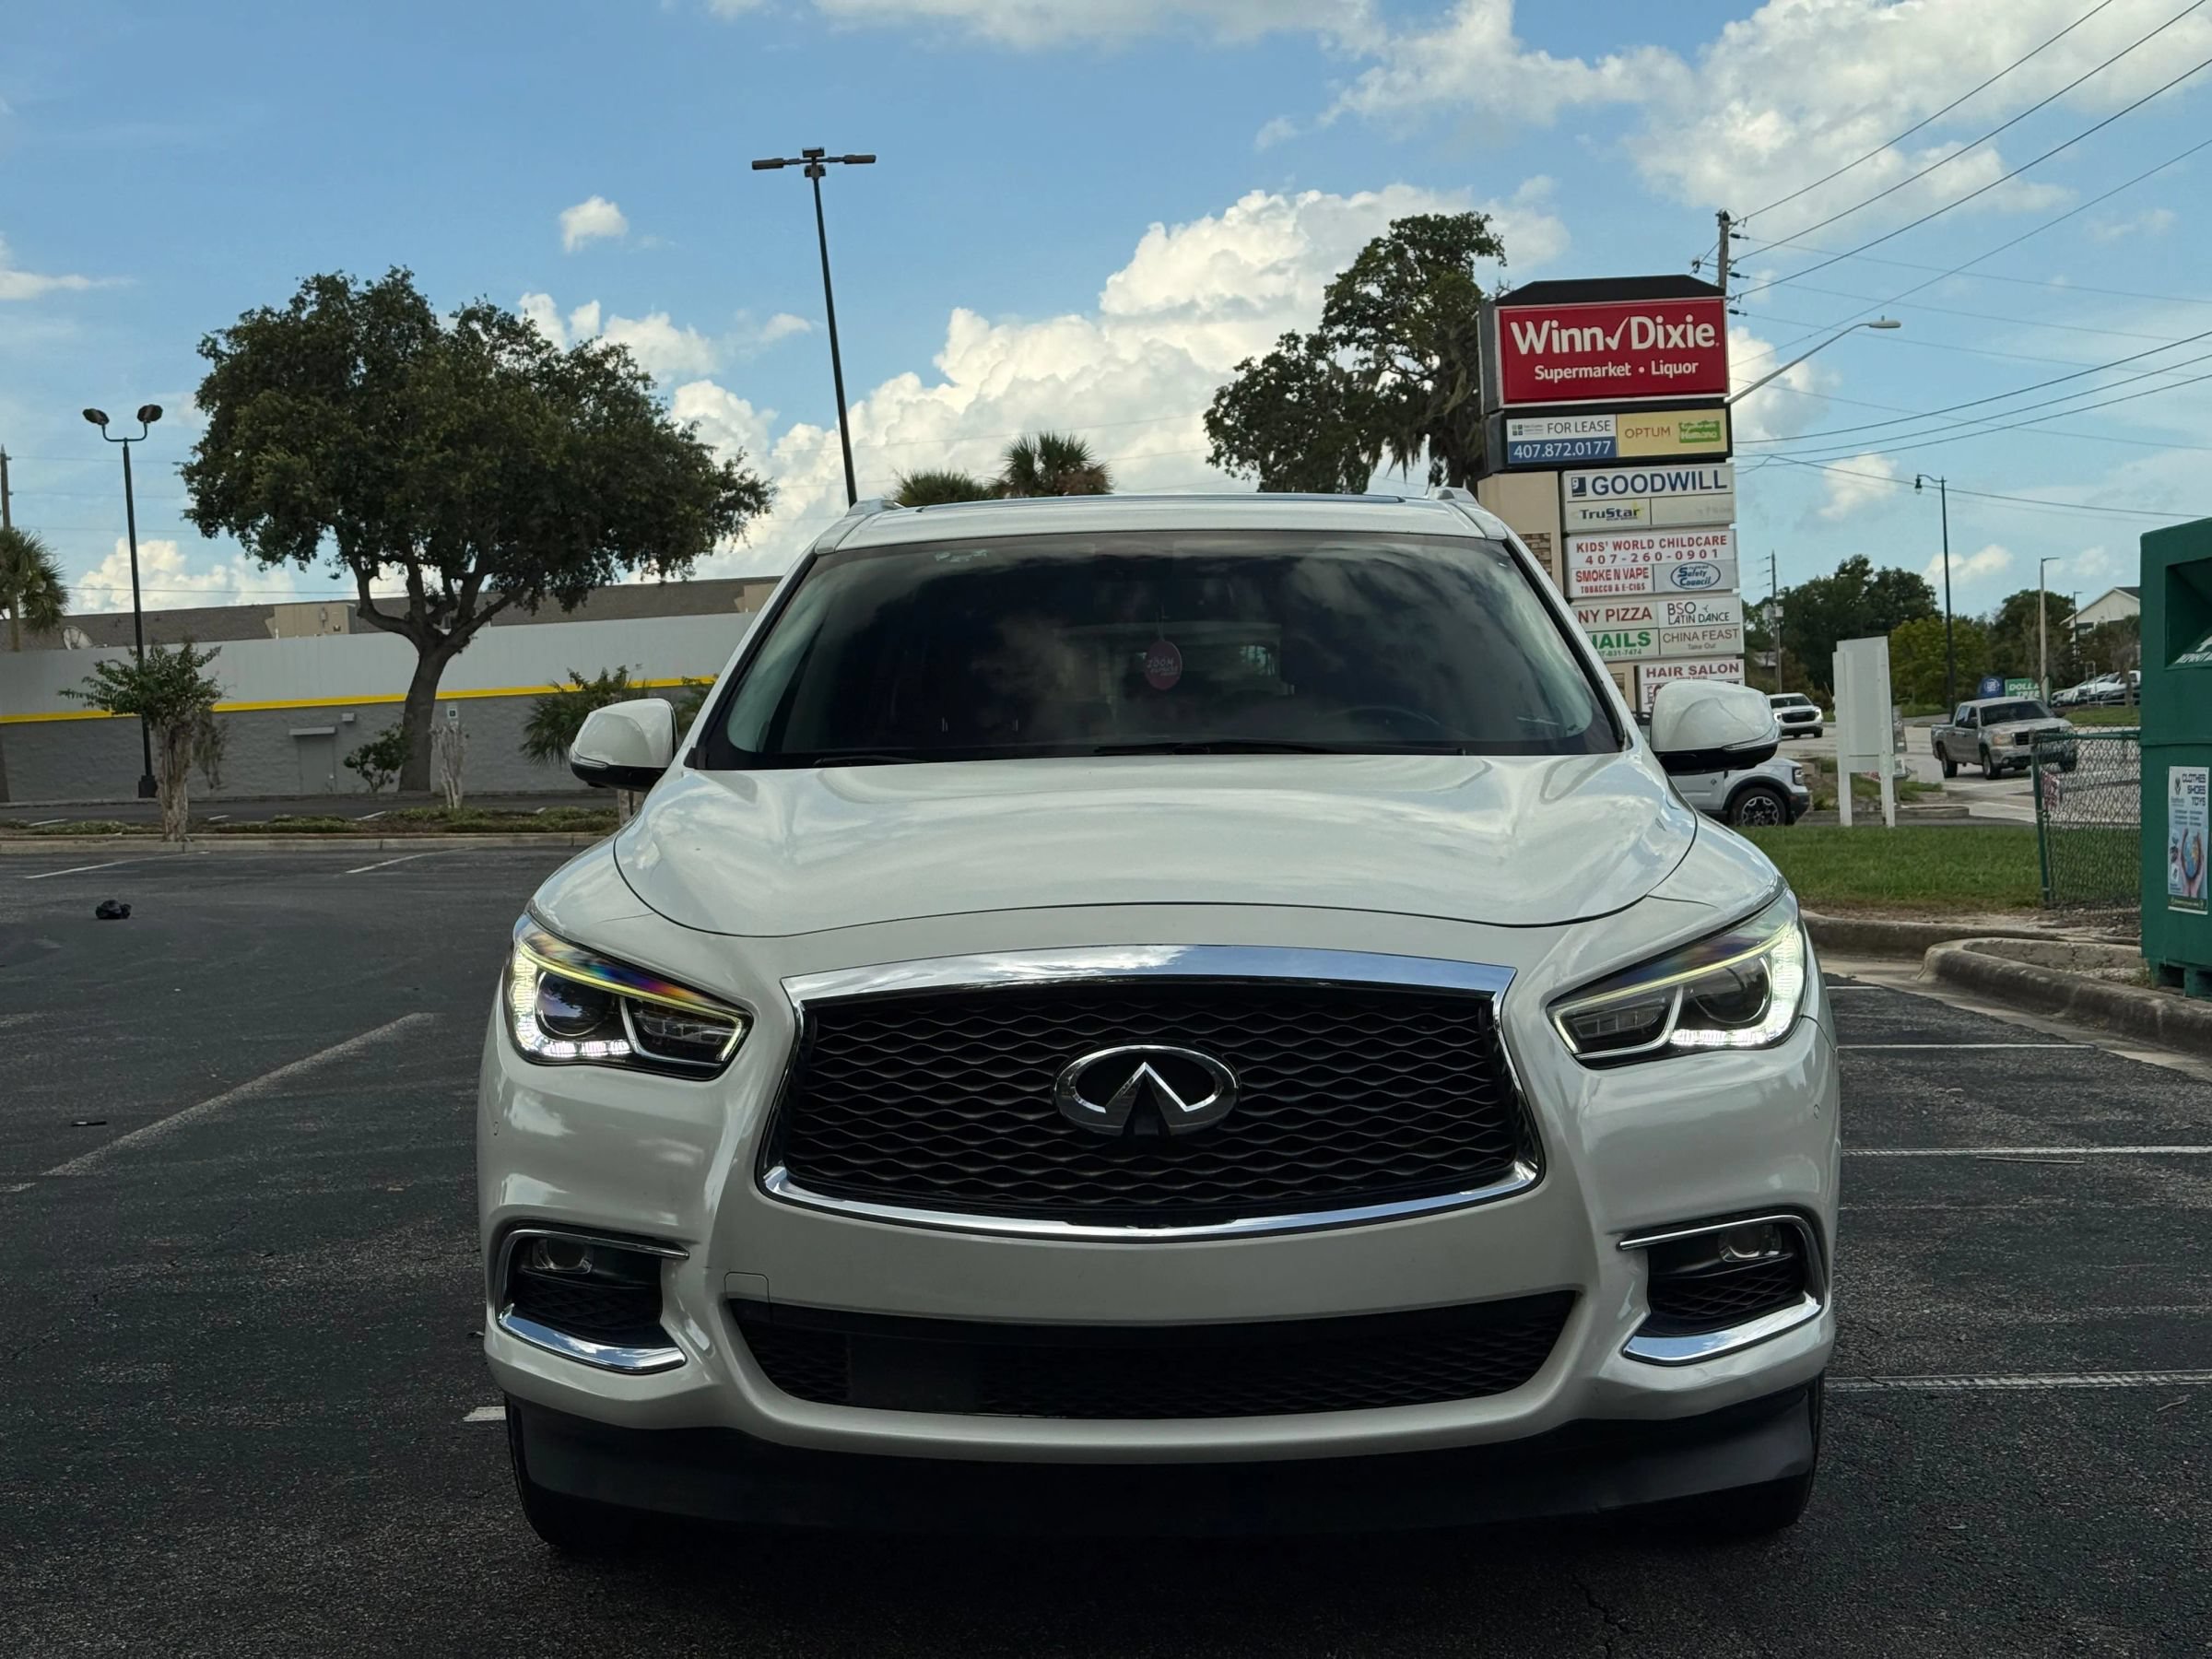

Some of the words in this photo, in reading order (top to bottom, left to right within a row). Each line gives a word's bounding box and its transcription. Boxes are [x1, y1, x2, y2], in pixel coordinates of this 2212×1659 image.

[1510, 320, 1604, 355] Winn
[1630, 314, 1715, 350] Dixie
[1535, 361, 1631, 383] Supermarket
[1651, 359, 1699, 378] Liquor
[1547, 421, 1571, 434] FOR
[1574, 420, 1611, 433] LEASE
[1624, 427, 1671, 439] OPTUM
[1513, 441, 1611, 459] 407.872.0177
[1592, 470, 1728, 496] GOODWILL
[1580, 507, 1641, 520] TruStar
[1576, 541, 1609, 553] KIDS'
[1613, 539, 1655, 551] WORLD
[1659, 535, 1728, 549] CHILDCARE
[1585, 548, 1720, 565] 407-260-0901
[1575, 569, 1612, 582] SMOKE
[1614, 569, 1621, 581] N
[1623, 567, 1650, 580] VAPE
[1677, 566, 1708, 579] Safety
[1581, 584, 1613, 594] TOBACCO
[1621, 582, 1645, 592] E-CIGS
[1680, 576, 1712, 586] Council
[1578, 609, 1601, 624] NY
[1606, 606, 1653, 622] PIZZA
[1667, 602, 1697, 616] BSO
[1668, 613, 1696, 625] LATIN
[1698, 611, 1730, 622] DANCE
[1663, 630, 1700, 643] CHINA
[1701, 629, 1739, 640] FEAST
[1646, 665, 1683, 678] HAIR
[1688, 663, 1739, 677] SALON
[2183, 773, 2206, 783] CLOTHES
[2187, 784, 2206, 794] SHOES
[2191, 796, 2206, 806] TOYS
